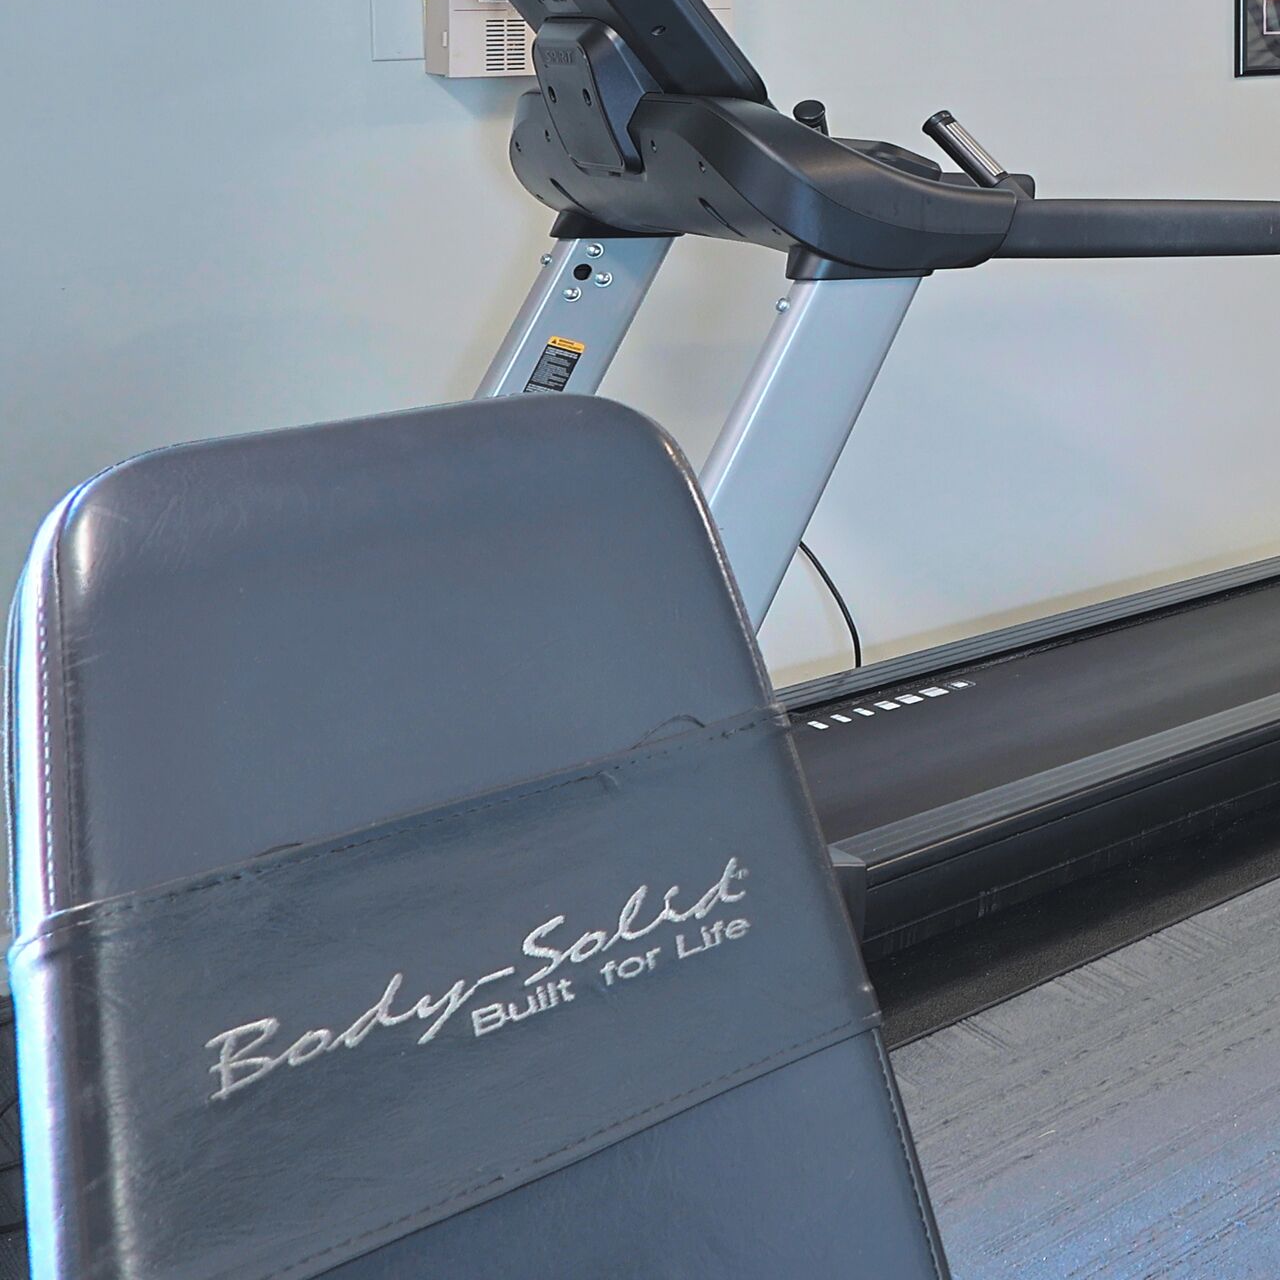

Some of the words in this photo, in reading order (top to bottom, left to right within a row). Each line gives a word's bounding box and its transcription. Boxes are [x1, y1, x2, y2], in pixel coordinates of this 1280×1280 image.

[470, 976, 576, 1038] Built
[600, 947, 661, 987] for
[674, 916, 751, 961] Life
